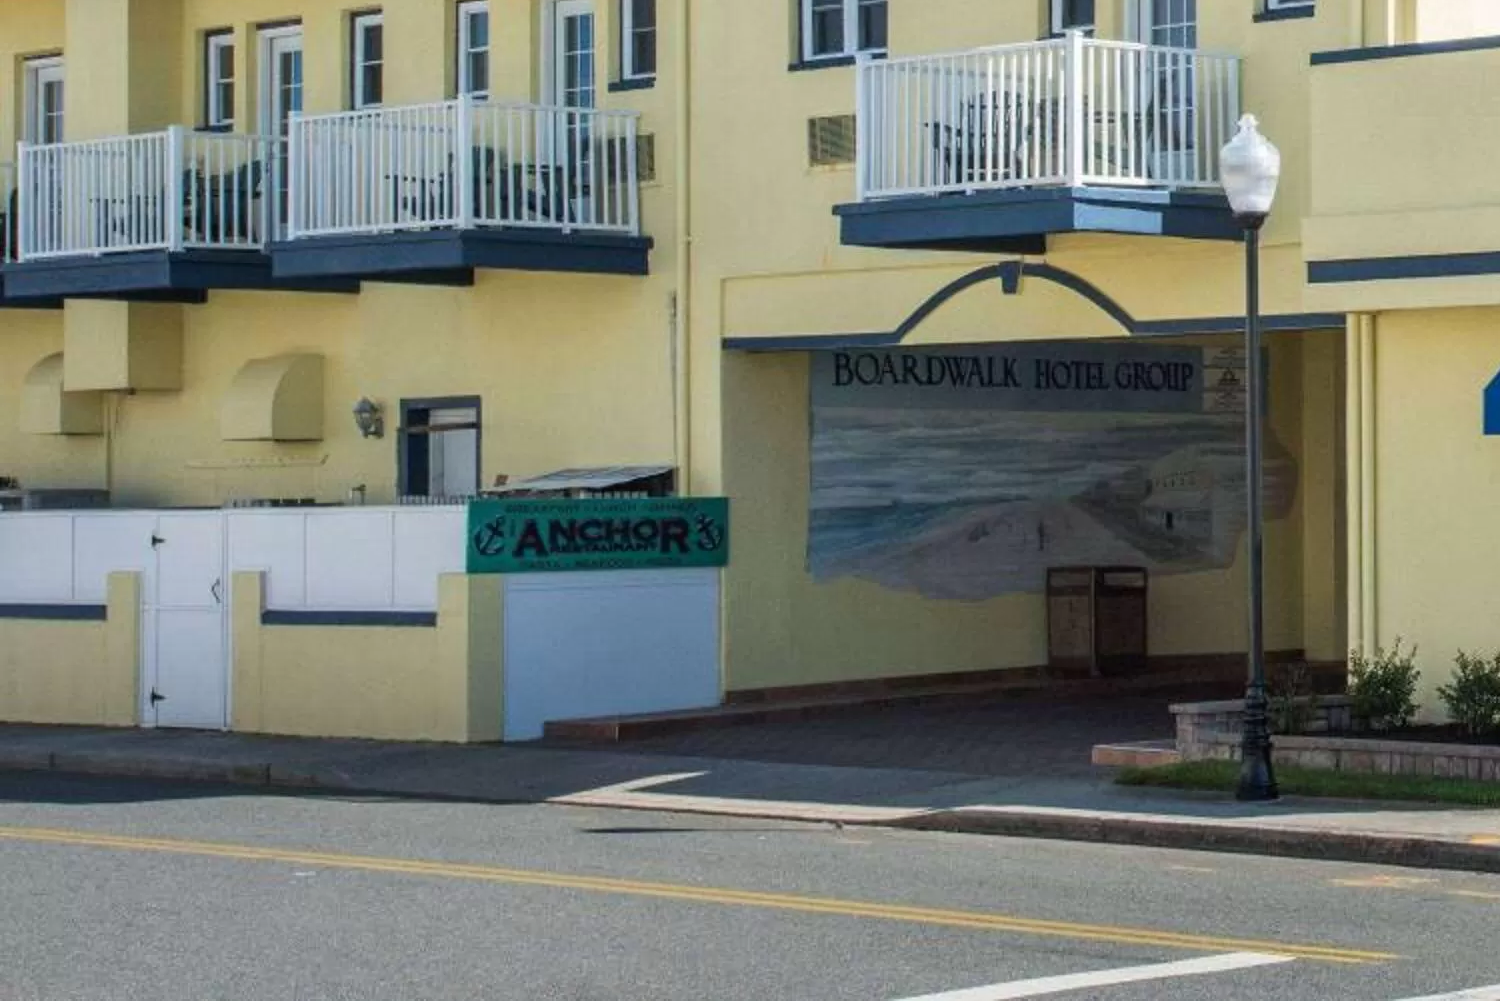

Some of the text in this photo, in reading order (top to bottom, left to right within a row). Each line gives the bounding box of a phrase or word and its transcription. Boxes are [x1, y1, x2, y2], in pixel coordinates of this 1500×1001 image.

[832, 351, 1021, 388] BOARDWALK
[1034, 358, 1109, 390] HOTEL
[1116, 360, 1195, 392] GROUP
[511, 517, 691, 558] ANCHOR
